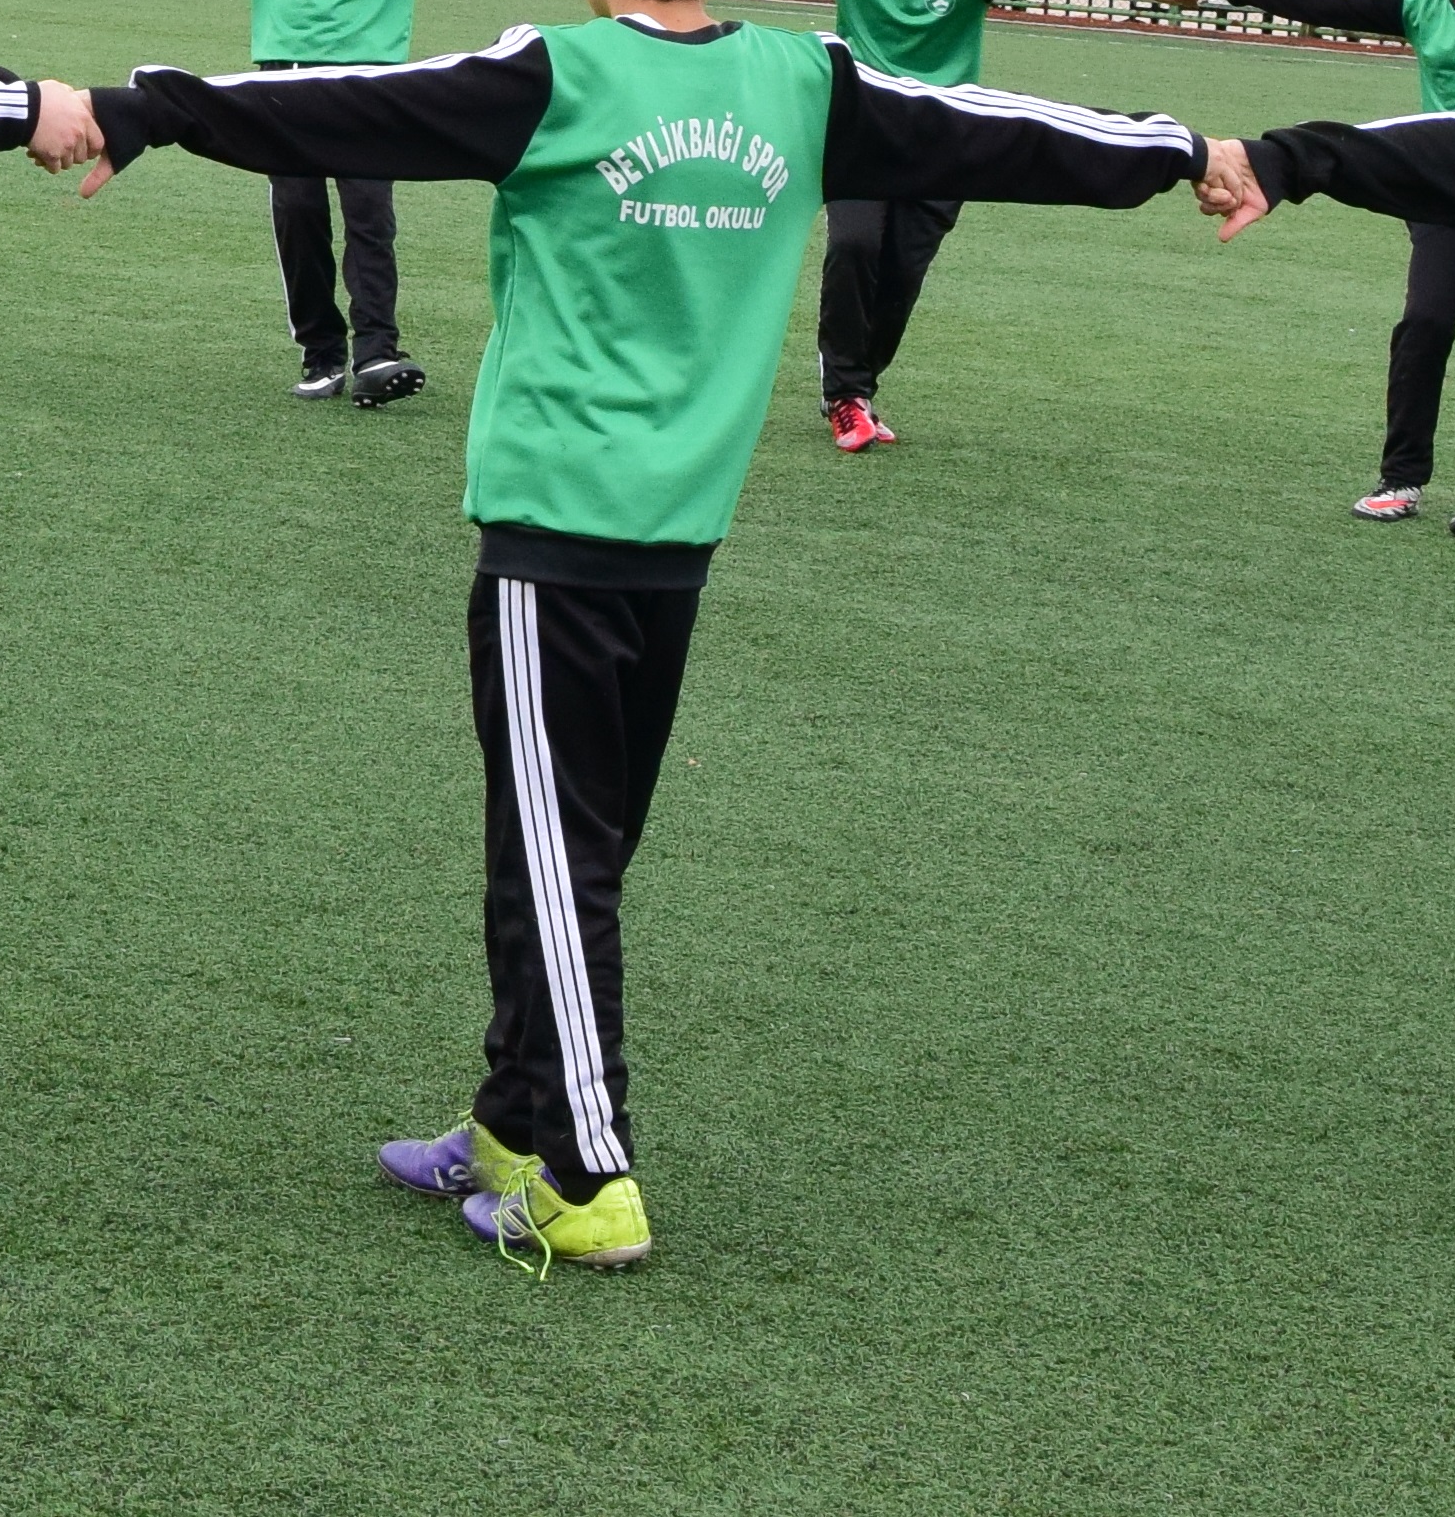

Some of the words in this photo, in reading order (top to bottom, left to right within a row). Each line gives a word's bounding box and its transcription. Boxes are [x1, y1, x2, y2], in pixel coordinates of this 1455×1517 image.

[595, 111, 743, 195] BEYLİKBAĞI
[742, 134, 789, 203] SPOR
[619, 199, 700, 228] FUTBOL
[705, 206, 766, 229] OKULU
